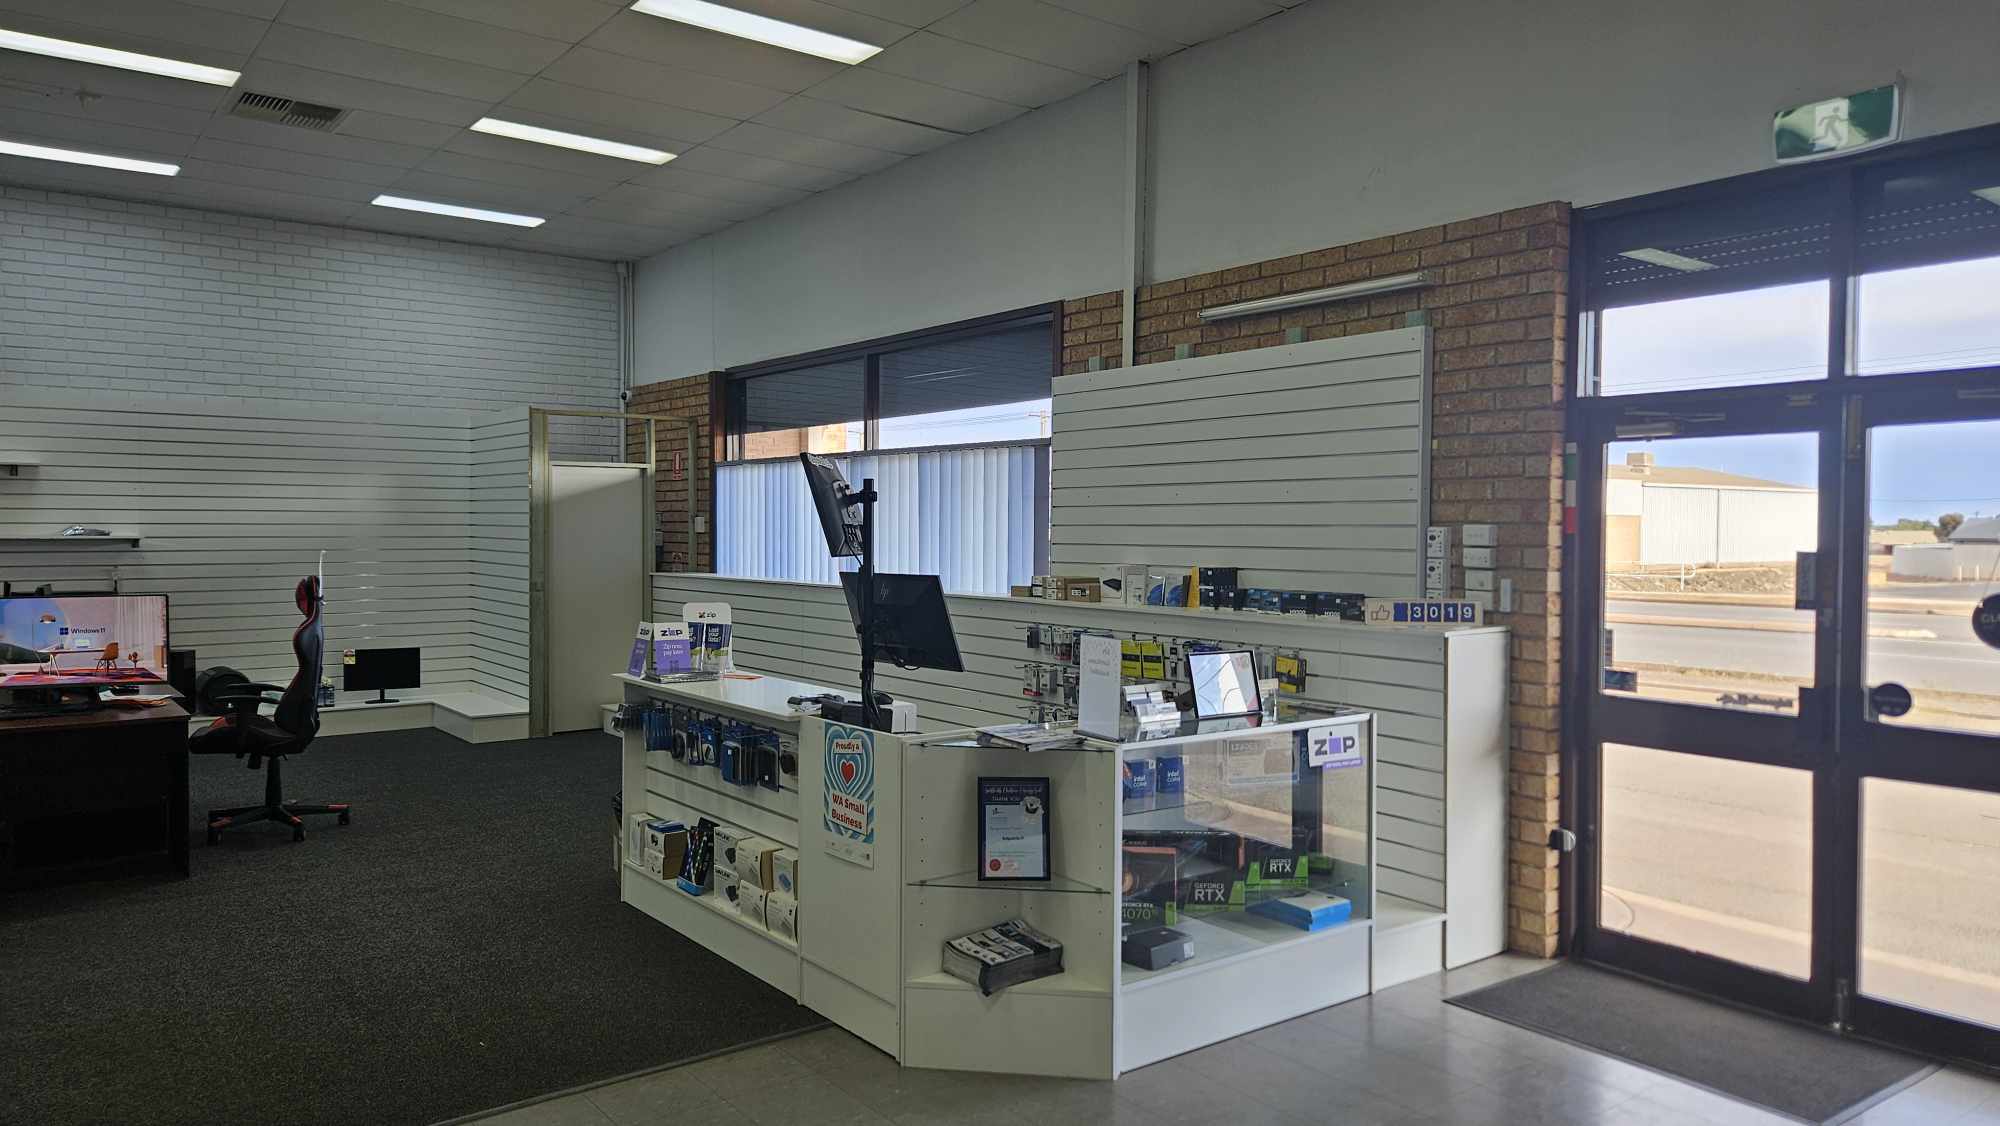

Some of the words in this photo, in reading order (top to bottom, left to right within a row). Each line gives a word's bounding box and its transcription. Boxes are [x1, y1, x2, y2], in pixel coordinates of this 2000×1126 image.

[1413, 606, 1473, 619] 3019
[71, 627, 100, 635] Windows
[660, 627, 683, 637] zip
[835, 741, 856, 752] Proudly
[832, 793, 844, 805] WA
[844, 797, 865, 816] Small
[831, 808, 863, 830] Business
[1269, 864, 1292, 873] RTX
[1194, 888, 1225, 902] RTX
